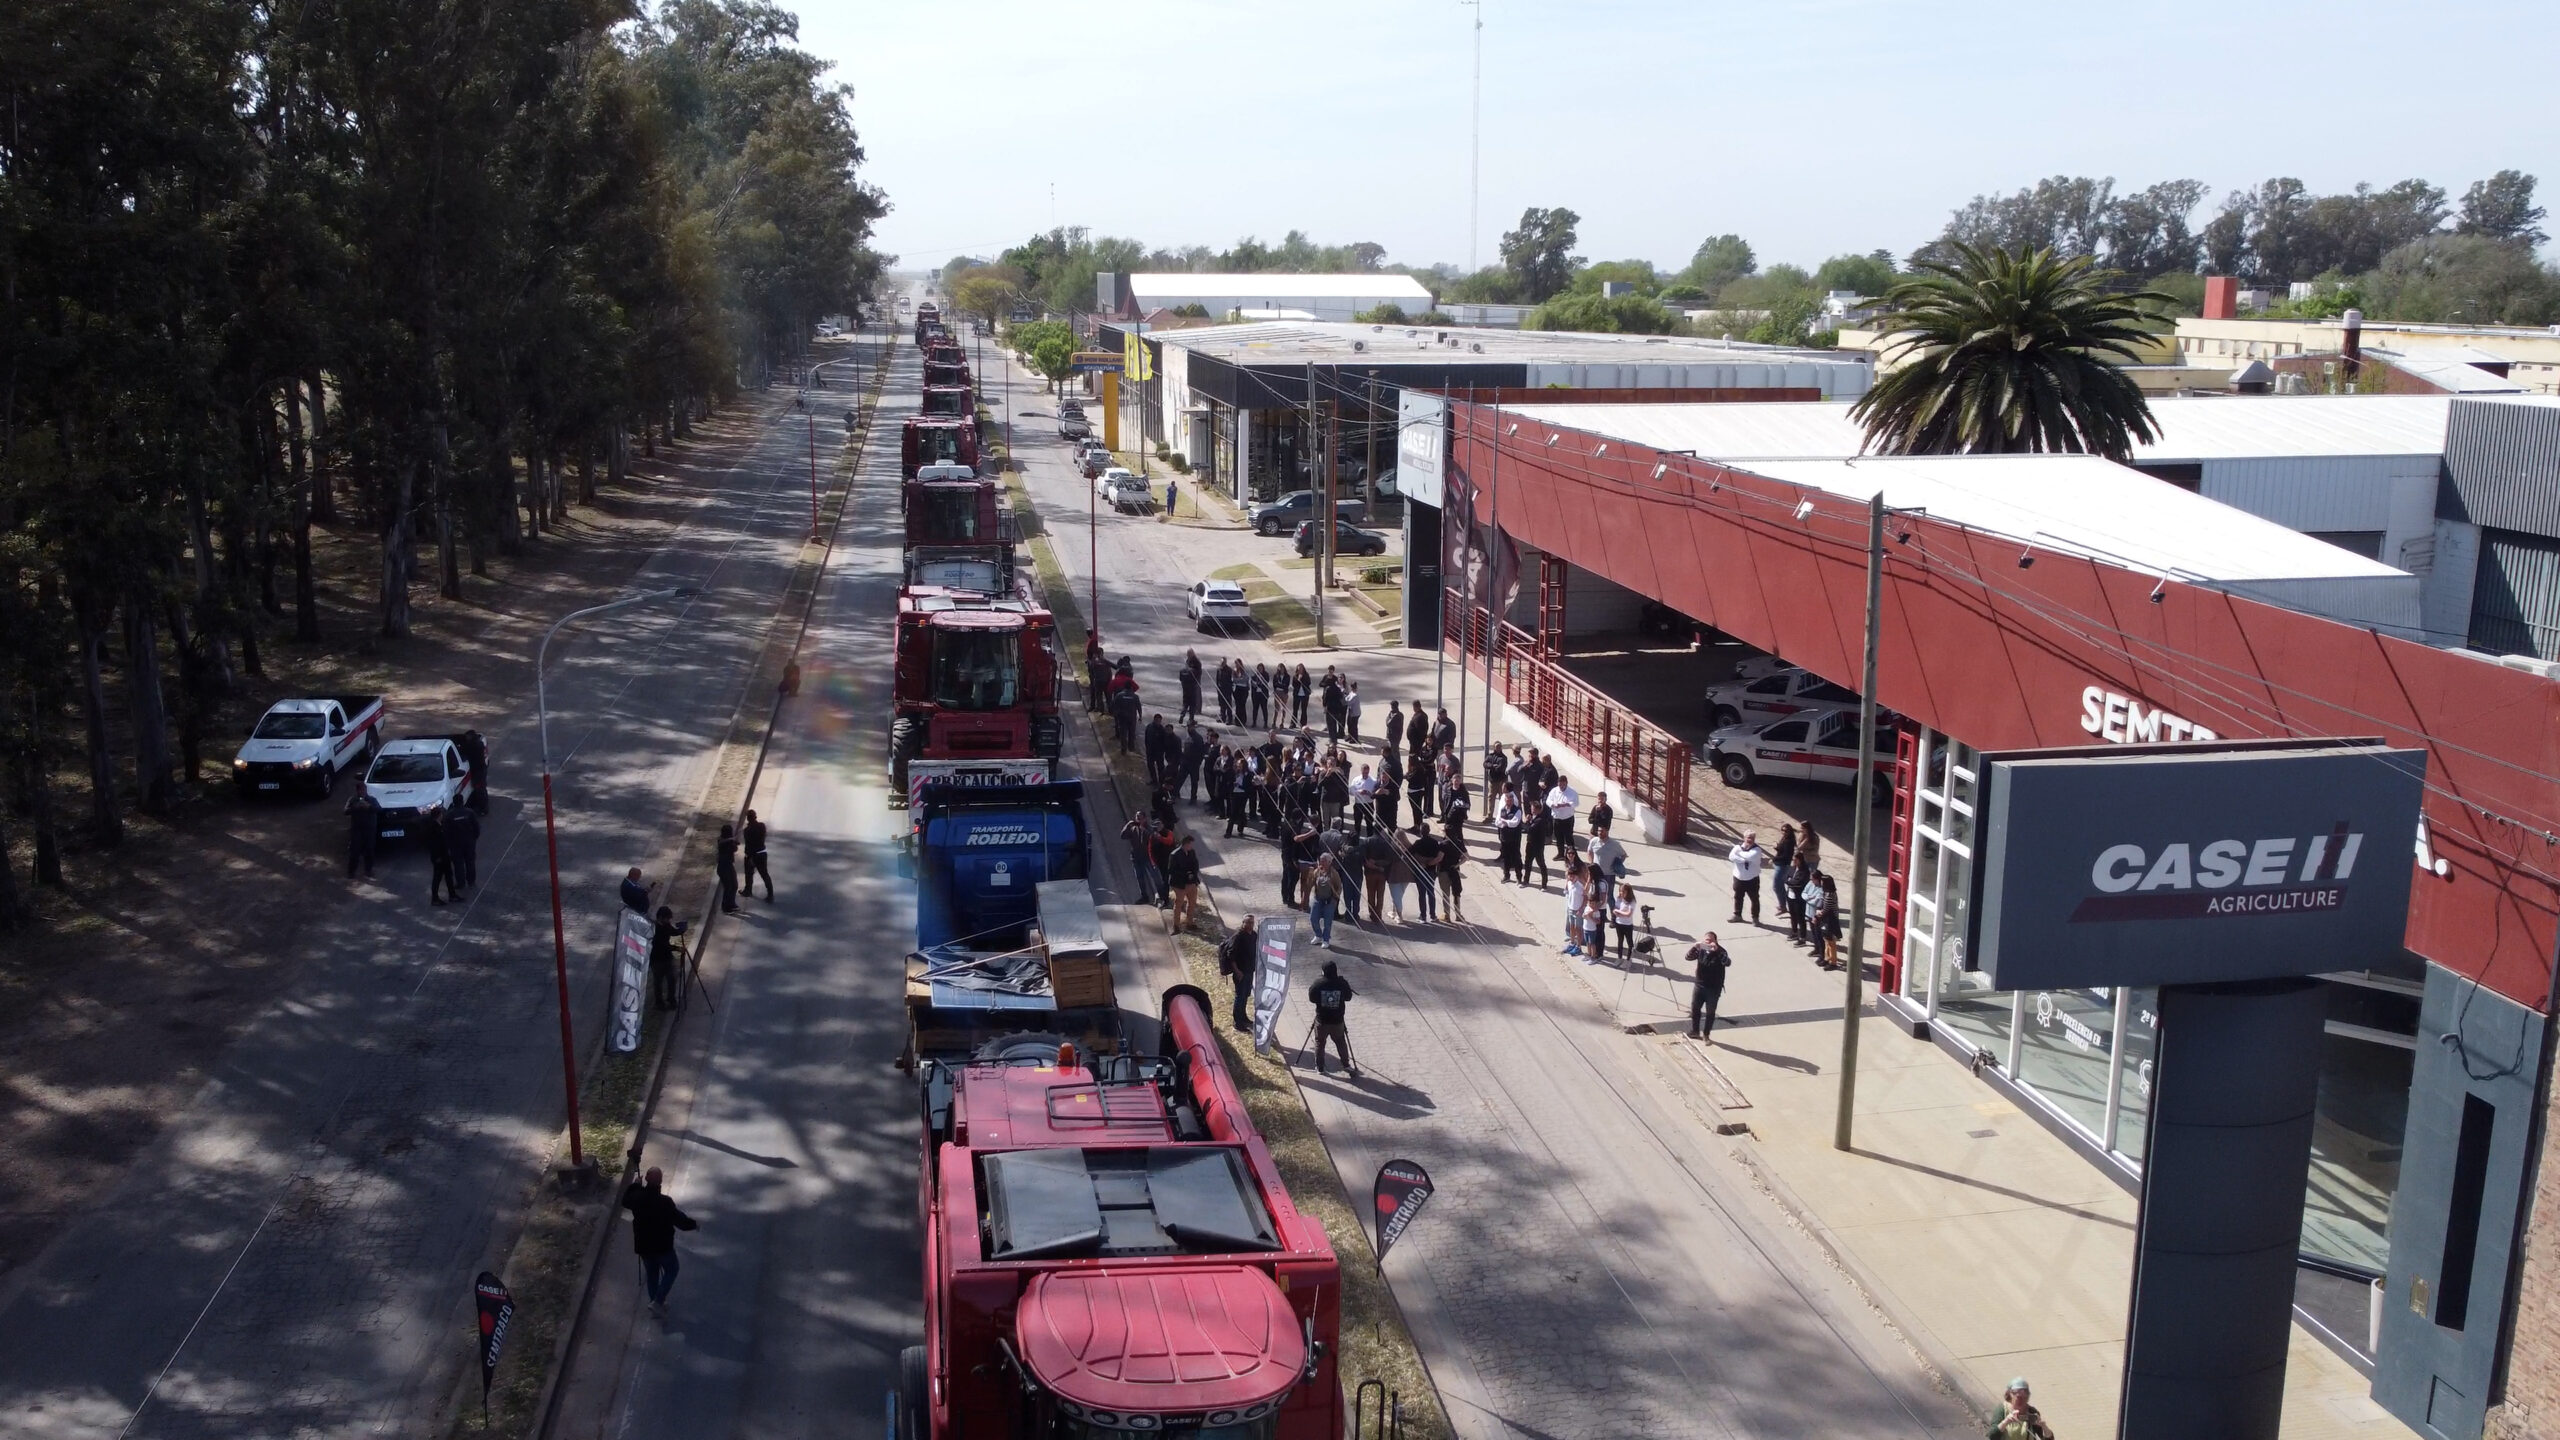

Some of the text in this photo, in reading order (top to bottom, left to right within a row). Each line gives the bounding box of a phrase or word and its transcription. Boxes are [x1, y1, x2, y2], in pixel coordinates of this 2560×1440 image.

[971, 825, 1024, 833] TRANSPORTE
[966, 833, 1040, 846] ROBLEDO
[2092, 837, 2296, 893] CASE
[2206, 890, 2338, 914] AGRICULTURE
[1383, 1168, 1415, 1180] CASE
[1382, 1187, 1429, 1244] SEMTRACO
[478, 1284, 499, 1295] CASE
[487, 1304, 513, 1367] SEMTRACO
